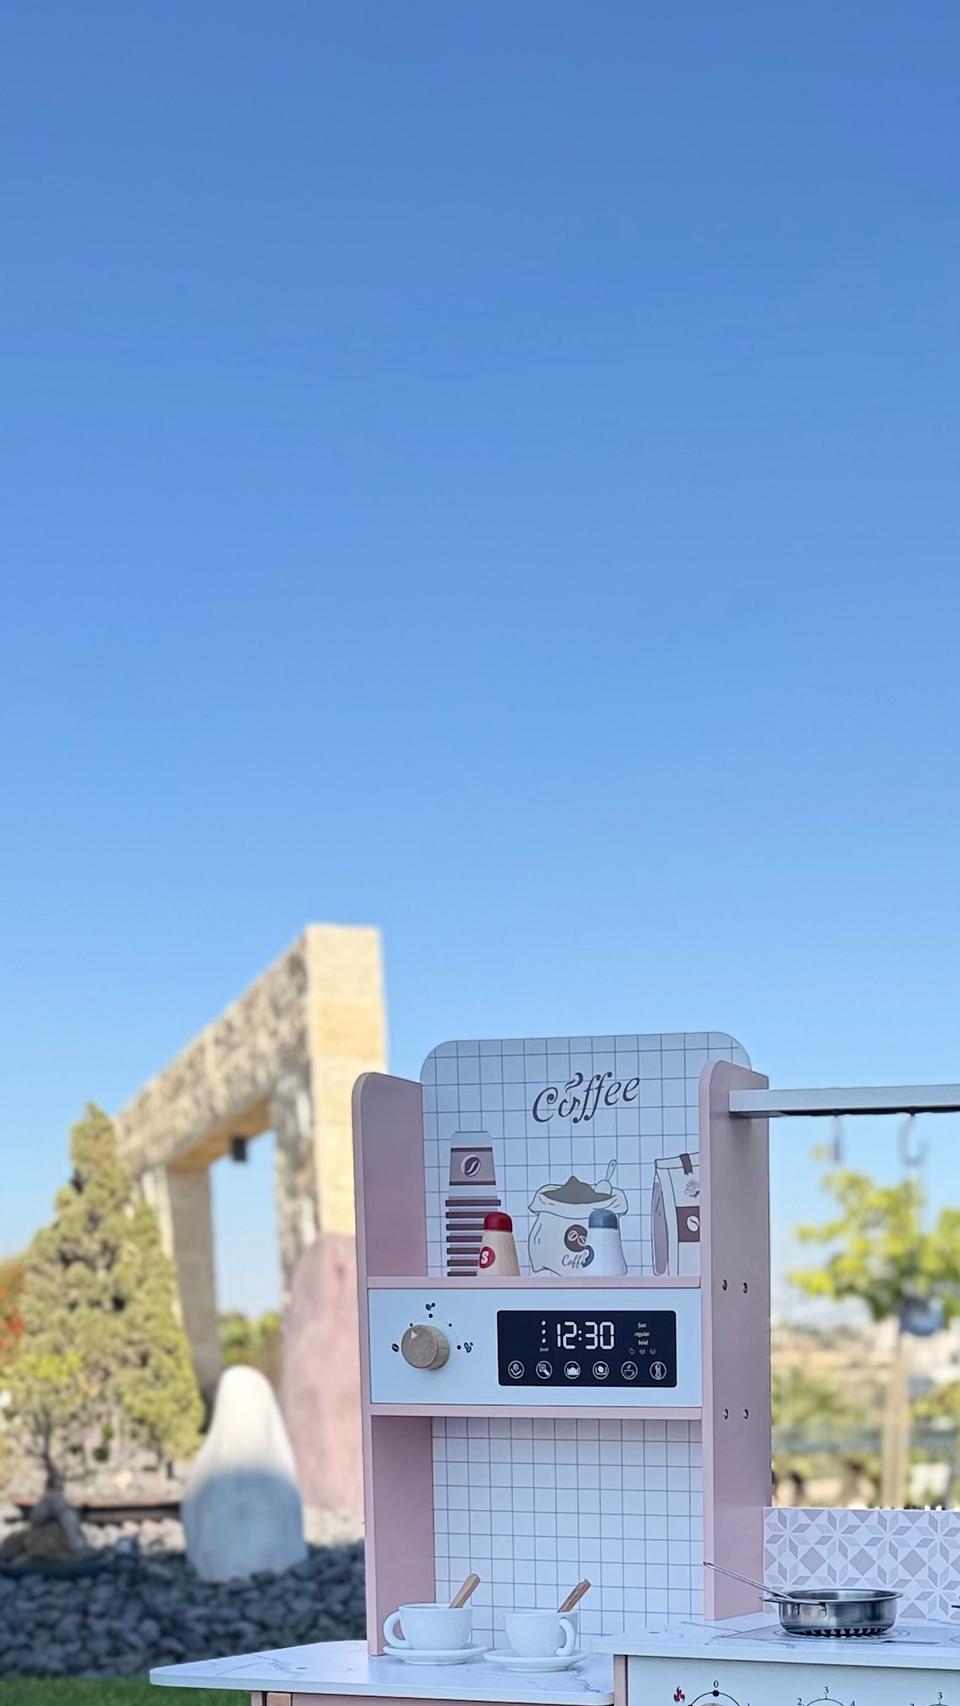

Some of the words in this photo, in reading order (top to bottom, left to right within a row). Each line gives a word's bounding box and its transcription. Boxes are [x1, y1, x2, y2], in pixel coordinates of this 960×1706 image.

[532, 1071, 640, 1123] Coffee
[557, 1321, 615, 1349] 12:30
[798, 1698, 802, 1706] 2
